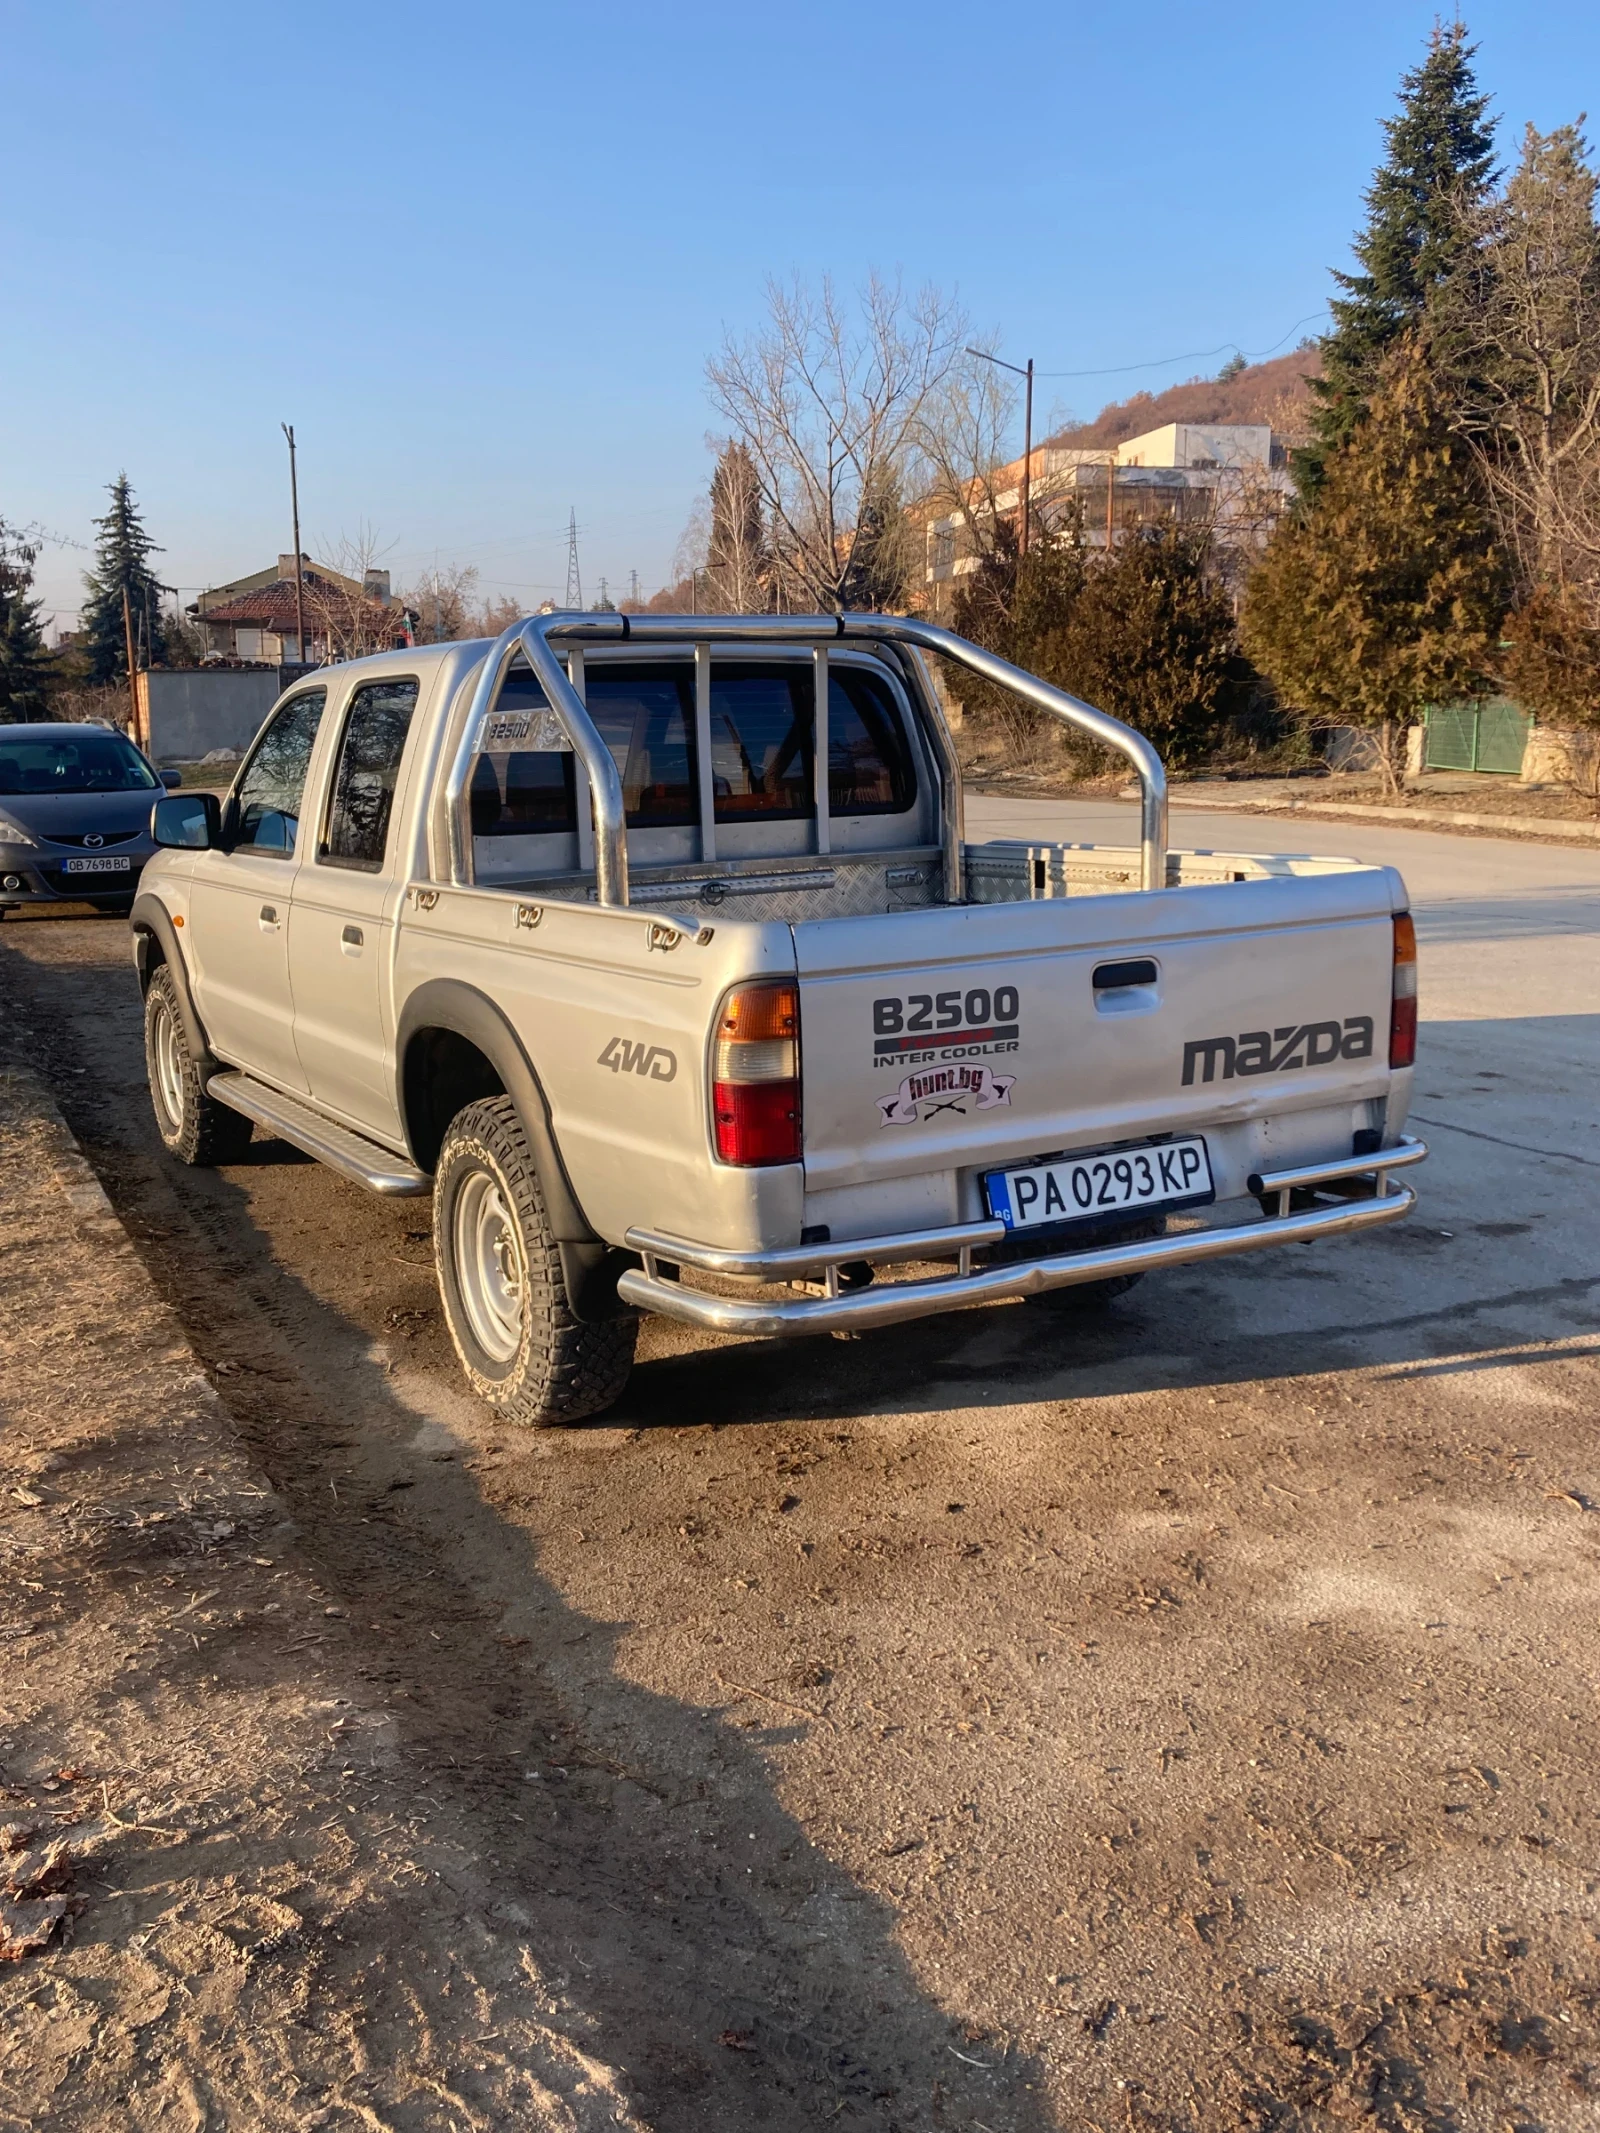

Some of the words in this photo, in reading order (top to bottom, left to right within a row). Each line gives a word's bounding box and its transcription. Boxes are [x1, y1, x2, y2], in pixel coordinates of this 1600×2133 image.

[85, 859, 112, 871] 7698
[873, 986, 1019, 1035] B2500
[873, 1051, 935, 1068] INTER
[940, 1041, 1019, 1060] COOLER
[898, 1028, 995, 1051] TURBO
[597, 1037, 677, 1082] 4WD
[909, 1067, 983, 1101] hunt.bg
[1014, 1171, 1066, 1220] PA
[1072, 1156, 1155, 1208] 0293
[1158, 1147, 1200, 1193] KP
